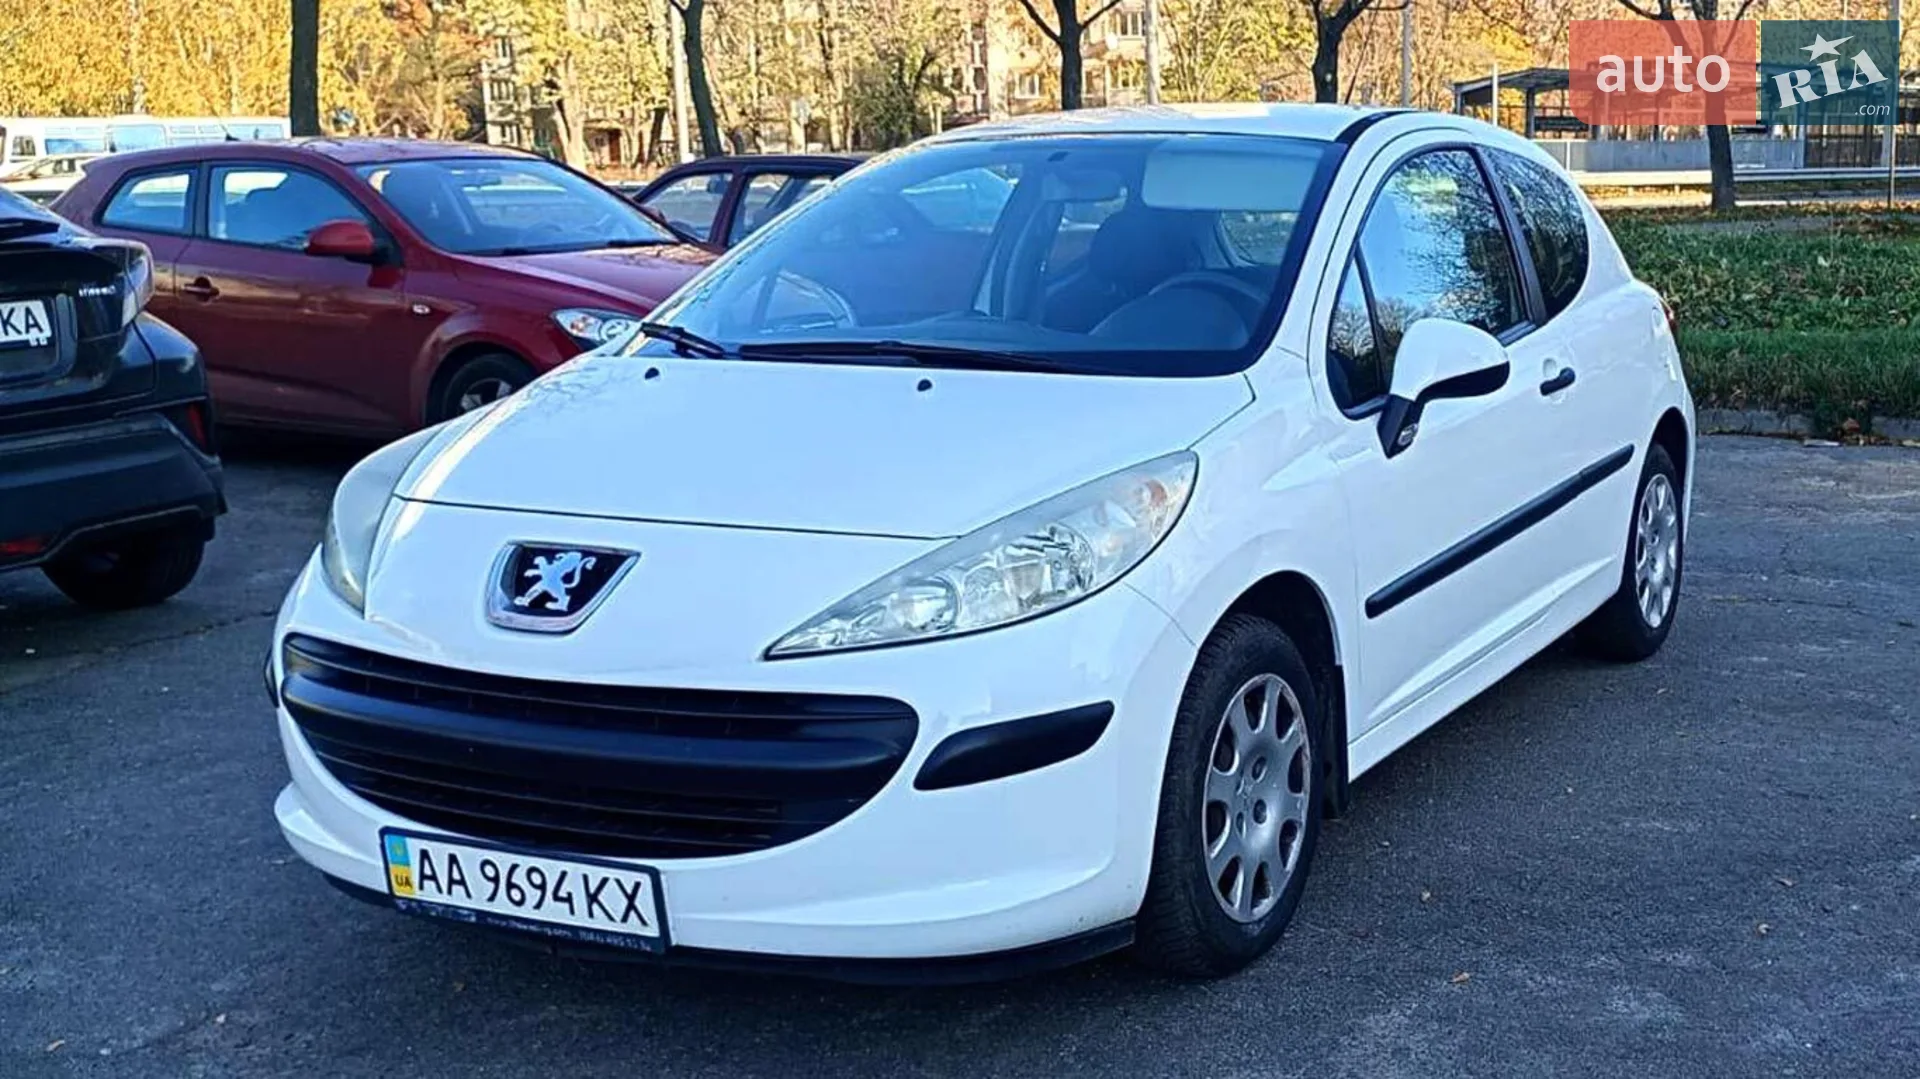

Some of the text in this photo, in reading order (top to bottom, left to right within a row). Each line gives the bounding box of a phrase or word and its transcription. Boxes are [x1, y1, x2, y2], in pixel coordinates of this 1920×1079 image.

[0, 306, 44, 337] KA
[394, 874, 413, 889] UA
[418, 848, 473, 900] AA
[480, 858, 576, 917] 9694
[581, 873, 650, 928] KX
